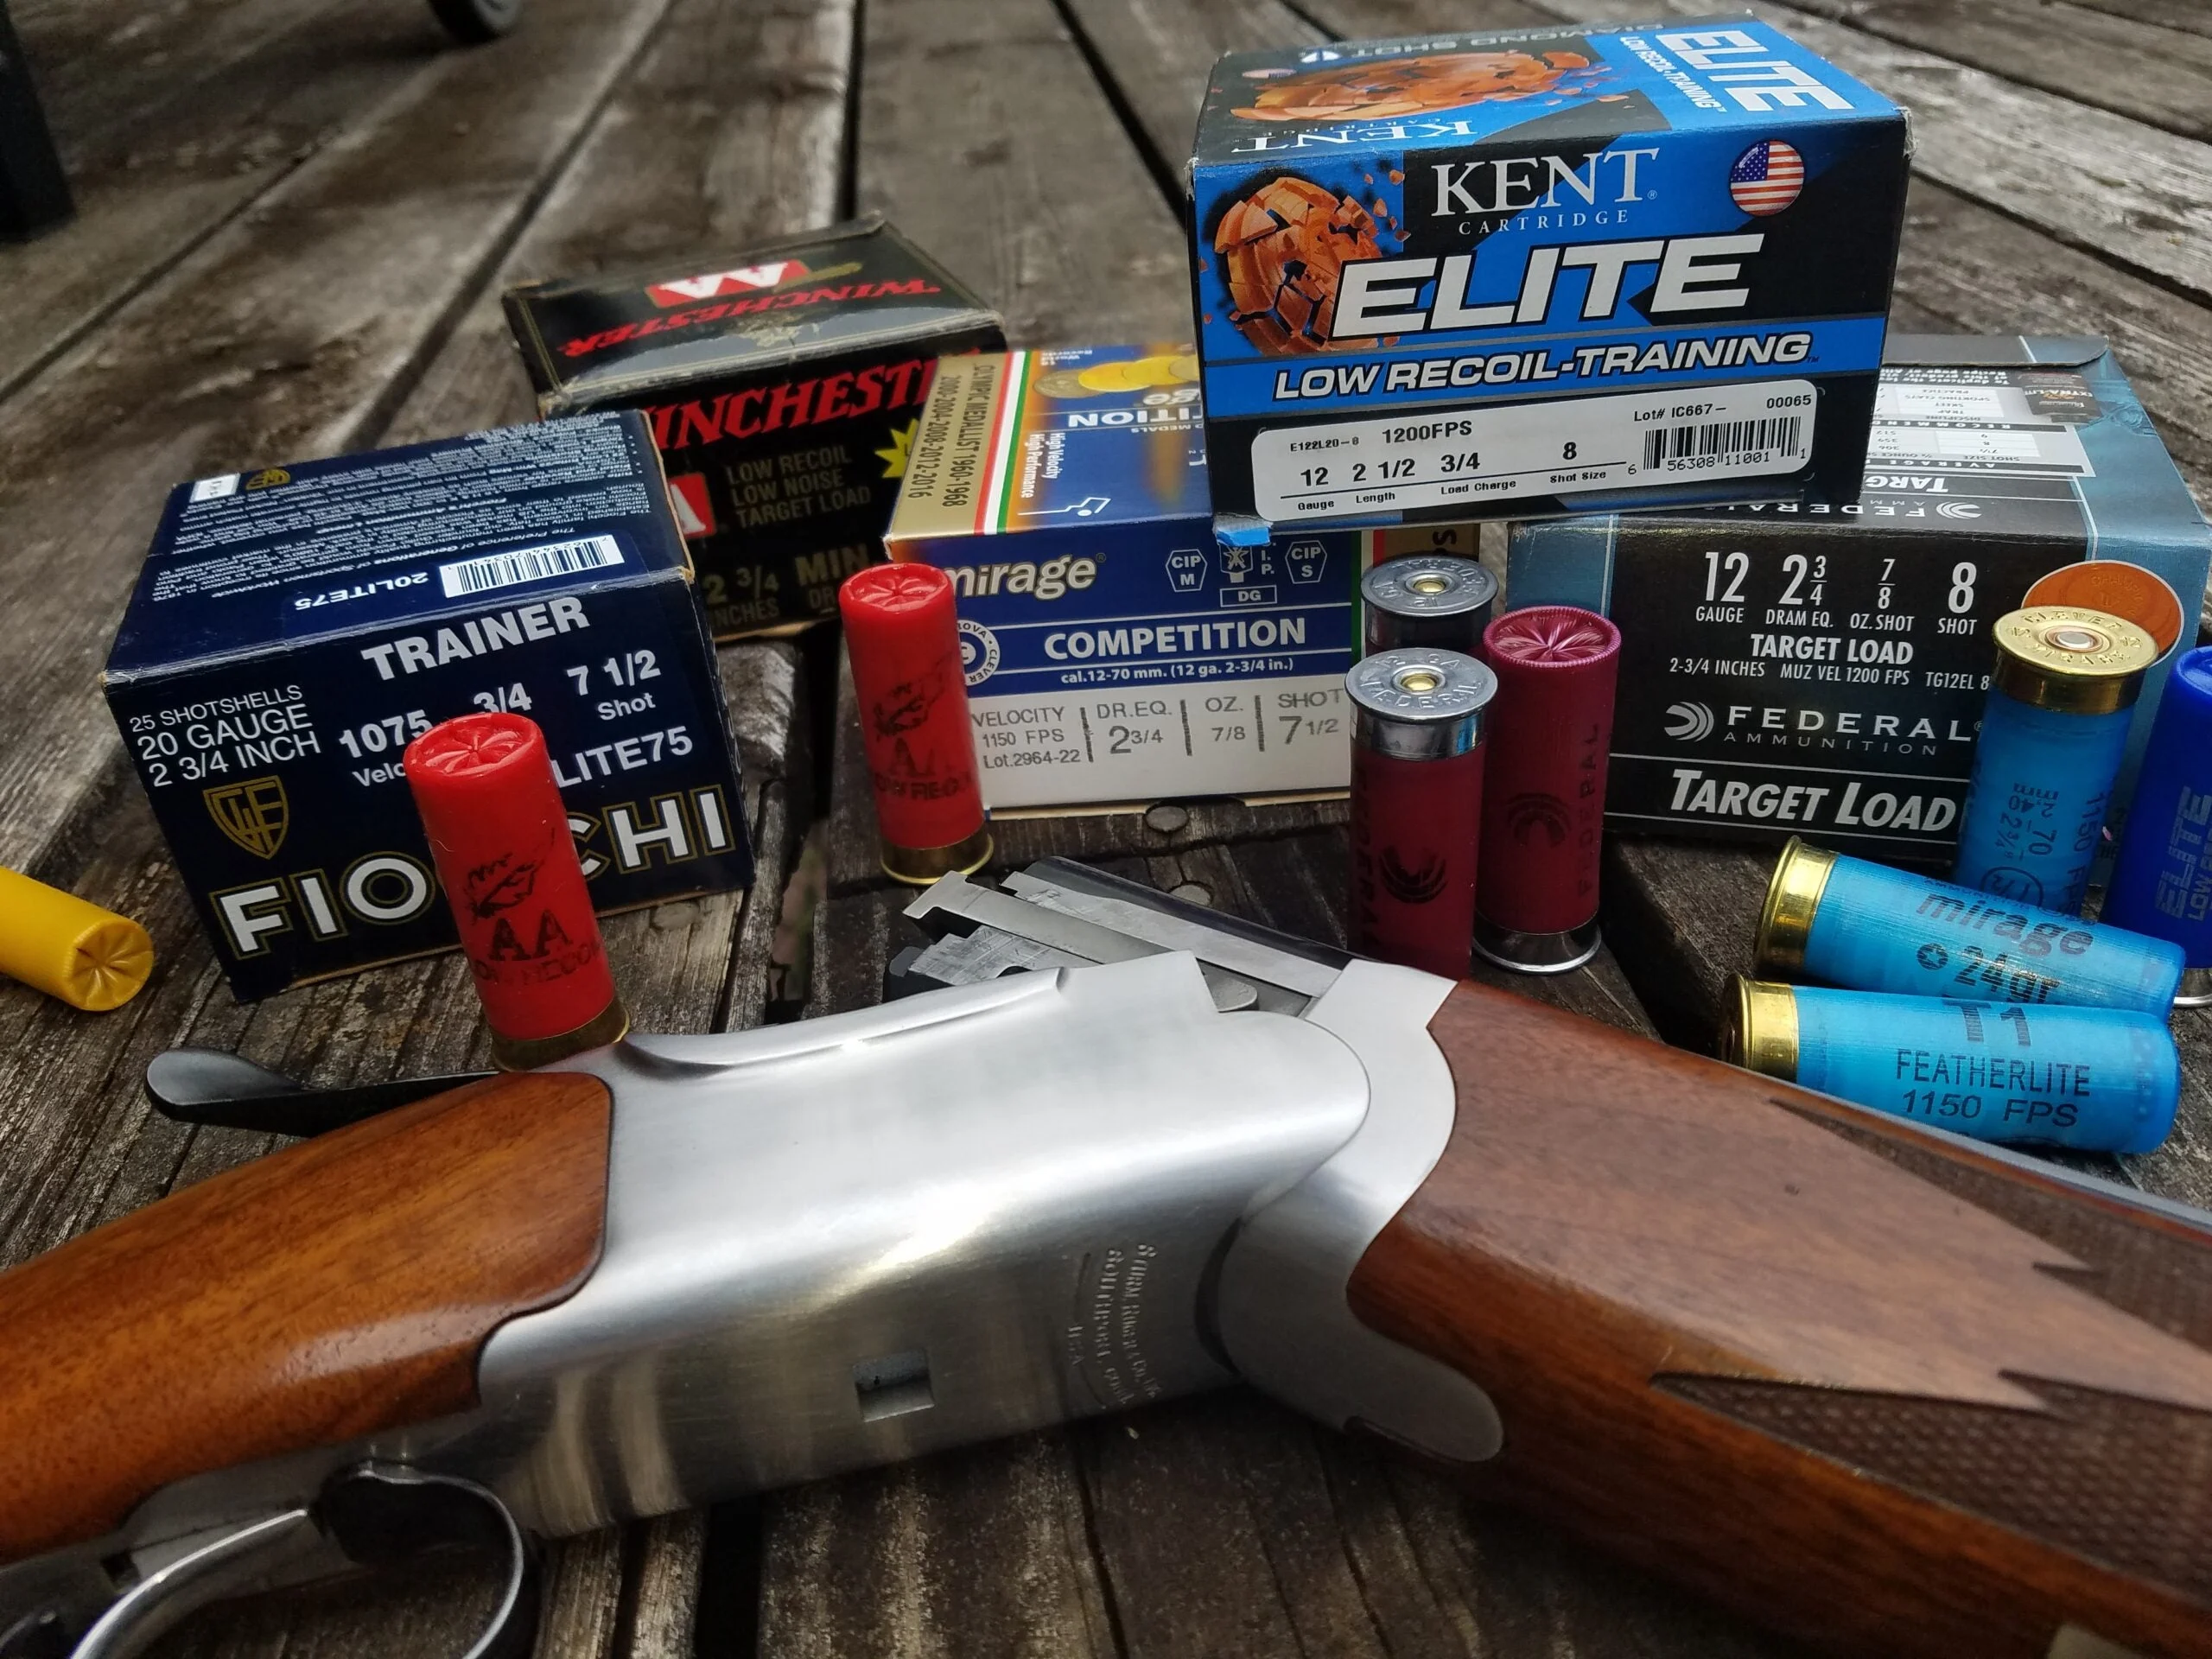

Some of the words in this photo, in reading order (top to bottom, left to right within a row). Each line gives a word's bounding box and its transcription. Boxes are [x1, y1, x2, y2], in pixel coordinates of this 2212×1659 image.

[1352, 41, 1457, 58] SHOT
[1656, 29, 1856, 111] ELITE
[1230, 120, 1479, 153] KENT
[1431, 148, 1660, 217] KENT
[1459, 209, 1628, 236] CARTRIDGE
[1331, 233, 1764, 339] ELITE
[560, 278, 941, 357] WINCHESTER
[967, 363, 995, 403] OLYMPIC
[1274, 366, 1381, 402] LOW
[1385, 333, 1813, 392] RECOIL-TRAINING
[955, 400, 988, 453] MEDALLIST
[1634, 407, 1666, 422] Lot#
[1766, 394, 1812, 410] 00065
[1872, 420, 2011, 429] RECOMMEND
[907, 373, 961, 499] 2000-2004-2008-2012-2016
[1025, 434, 1045, 451] High
[1046, 433, 1065, 450] High
[1130, 423, 1192, 434] MEDALS
[1382, 420, 1472, 444] 1200FPS
[726, 456, 774, 485] LOW
[779, 445, 854, 476] RECOIL
[941, 453, 977, 508] 1960-1968
[1020, 449, 1043, 499] Performance
[1041, 448, 1065, 479] Velocity
[1300, 467, 1329, 486] 12
[1352, 463, 1366, 482] 2
[1377, 458, 1415, 480] 1/2
[1440, 452, 1480, 474] 3/4
[1561, 442, 1578, 460] 8
[1628, 464, 1637, 475] 6
[1667, 455, 1715, 472] 56308
[1725, 452, 1770, 466] 11001
[1800, 448, 1807, 460] 1
[1890, 460, 1996, 468] AVERAGE
[729, 480, 781, 507] LOW
[784, 468, 846, 499] NOISE
[1297, 499, 1335, 512] Gauge
[1355, 492, 1395, 505] Length
[1440, 483, 1469, 495] Load
[1474, 479, 1516, 492] Charge
[1549, 472, 1577, 484] Shot
[1581, 469, 1606, 481] Size
[1866, 475, 1949, 493] TARG
[629, 506, 650, 515] The
[736, 495, 814, 530] TARGET
[821, 486, 871, 512] LOAD
[1728, 503, 1926, 518] FEDERA
[478, 530, 547, 547] Preference
[551, 526, 575, 535] The
[373, 544, 457, 566] Generations
[1171, 555, 1202, 569] CIP
[1261, 563, 1275, 575] P.
[1291, 546, 1321, 560] CIP
[1301, 565, 1313, 577] S
[295, 570, 430, 611] 20LITE75
[702, 574, 728, 604] 2
[735, 565, 780, 599] 3/4
[946, 553, 1097, 601] mirage
[1180, 573, 1195, 586] M
[1237, 590, 1262, 601] DG
[1705, 551, 1749, 602] 12
[1778, 554, 1808, 605] 2
[1948, 562, 1978, 613] 8
[360, 596, 590, 681] TRAINER
[1045, 617, 1306, 660] COMPETITION
[1695, 606, 1745, 623] GAUGE
[1765, 609, 1808, 627] DRAM
[1811, 610, 1834, 629] EQ.
[1850, 613, 1873, 630] OZ.
[1876, 614, 1916, 632] SHOT
[1937, 618, 1978, 636] SHOT
[969, 648, 998, 683] CLEVER
[1750, 632, 1841, 662] TARGET
[1847, 639, 1913, 665] LOAD
[1061, 668, 1130, 684] cal.12-70
[1134, 666, 1167, 679] mm.
[1170, 664, 1195, 679] (12
[1198, 663, 1222, 677] ga.
[1225, 658, 1265, 674] 2-3/4
[1268, 658, 1294, 671] in.)
[1669, 657, 1710, 675] 2-3/4
[1714, 660, 1765, 677] INCHES
[1780, 663, 1813, 680] MUZ
[1818, 664, 1841, 682] VEL
[1847, 666, 1879, 684] 1200
[1885, 668, 1910, 686] FPS
[1925, 671, 1975, 690] TG12EL
[130, 715, 156, 732] 25
[160, 684, 302, 726] SHOTSHELLS
[339, 709, 433, 760] 1075
[474, 683, 532, 714] 3/4
[567, 665, 589, 696] 7
[604, 649, 661, 687] 1/2
[598, 692, 657, 721] Shot
[972, 706, 1065, 728] VELOCITY
[1096, 700, 1172, 719] DR.EQ.
[1205, 696, 1243, 712] OZ.
[1278, 688, 1344, 709] SHOT
[1728, 705, 1972, 741] FEDERAL
[137, 732, 179, 760] 20
[187, 703, 313, 749] GAUGE
[982, 732, 1016, 747] 1150
[1026, 728, 1065, 745] FPS
[1211, 726, 1246, 741] 7/8
[1279, 715, 1302, 744] 7
[1306, 719, 1339, 735] 1/2
[1724, 732, 1936, 756] AMMUNITION
[149, 763, 173, 787] 2
[179, 750, 230, 780] 3/4
[235, 731, 321, 769] INCH
[551, 726, 693, 788] LITE75
[983, 749, 1081, 769] Lot.2964-22
[1670, 768, 1830, 822] TARGET
[1834, 781, 1957, 832] LOAD
[212, 787, 733, 956] FIOCHI
[2155, 785, 2212, 919] ELITE
[488, 909, 573, 962] AA
[1916, 893, 2094, 957] mirage
[1953, 945, 2061, 1004] 24gr
[1942, 996, 2031, 1046] T1
[1897, 1048, 2090, 1097] FEATHERLITE
[1903, 1089, 1982, 1120] 1150
[2003, 1098, 2079, 1128] FPS
